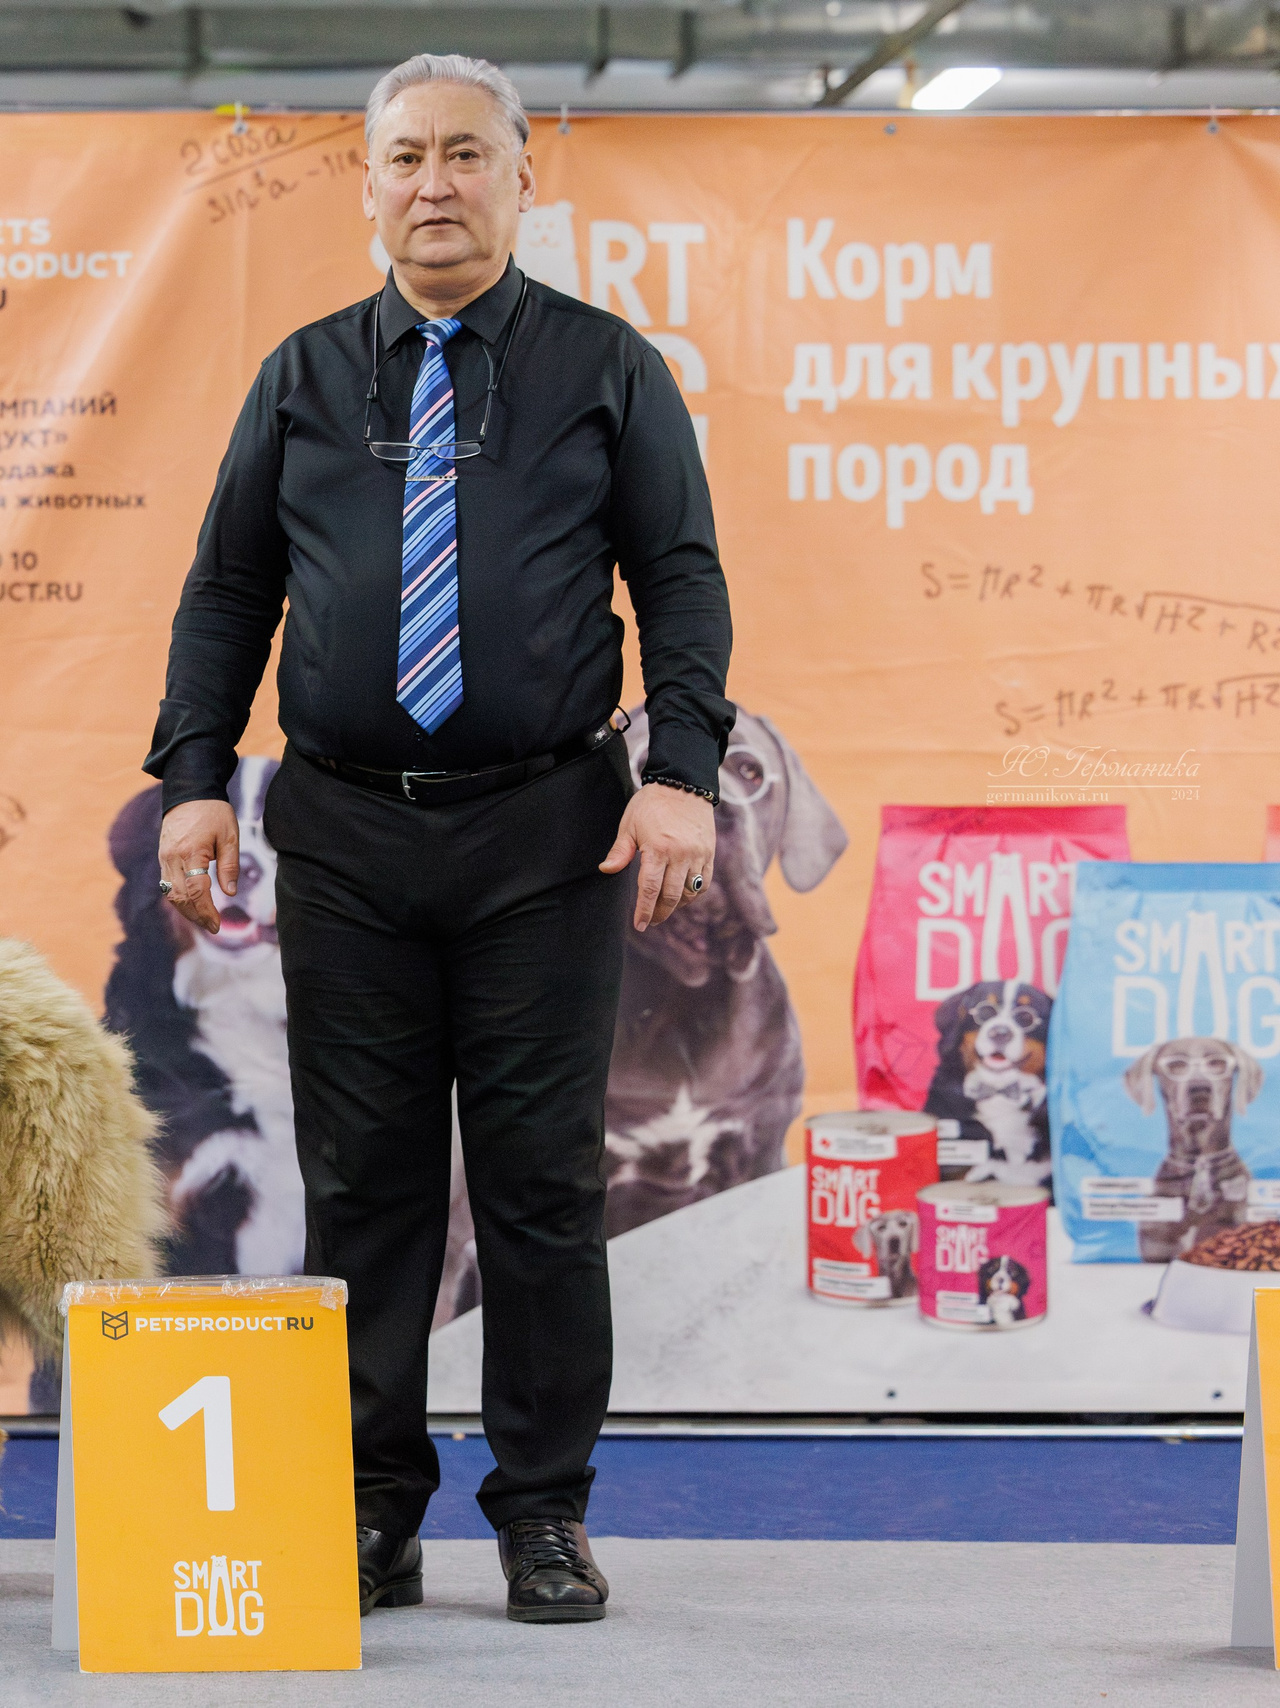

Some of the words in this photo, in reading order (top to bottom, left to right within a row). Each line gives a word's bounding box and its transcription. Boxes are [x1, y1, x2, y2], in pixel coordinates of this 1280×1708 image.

[786, 216, 994, 327] Корм
[783, 341, 934, 413] для
[951, 341, 1280, 428] крупны
[17, 493, 146, 510] животных
[787, 442, 1035, 529] пород
[11, 551, 38, 571] 10
[811, 1165, 881, 1191] SMART
[158, 1376, 236, 1512] 1
[173, 1555, 262, 1590] SMART
[175, 1590, 265, 1637] DOG
